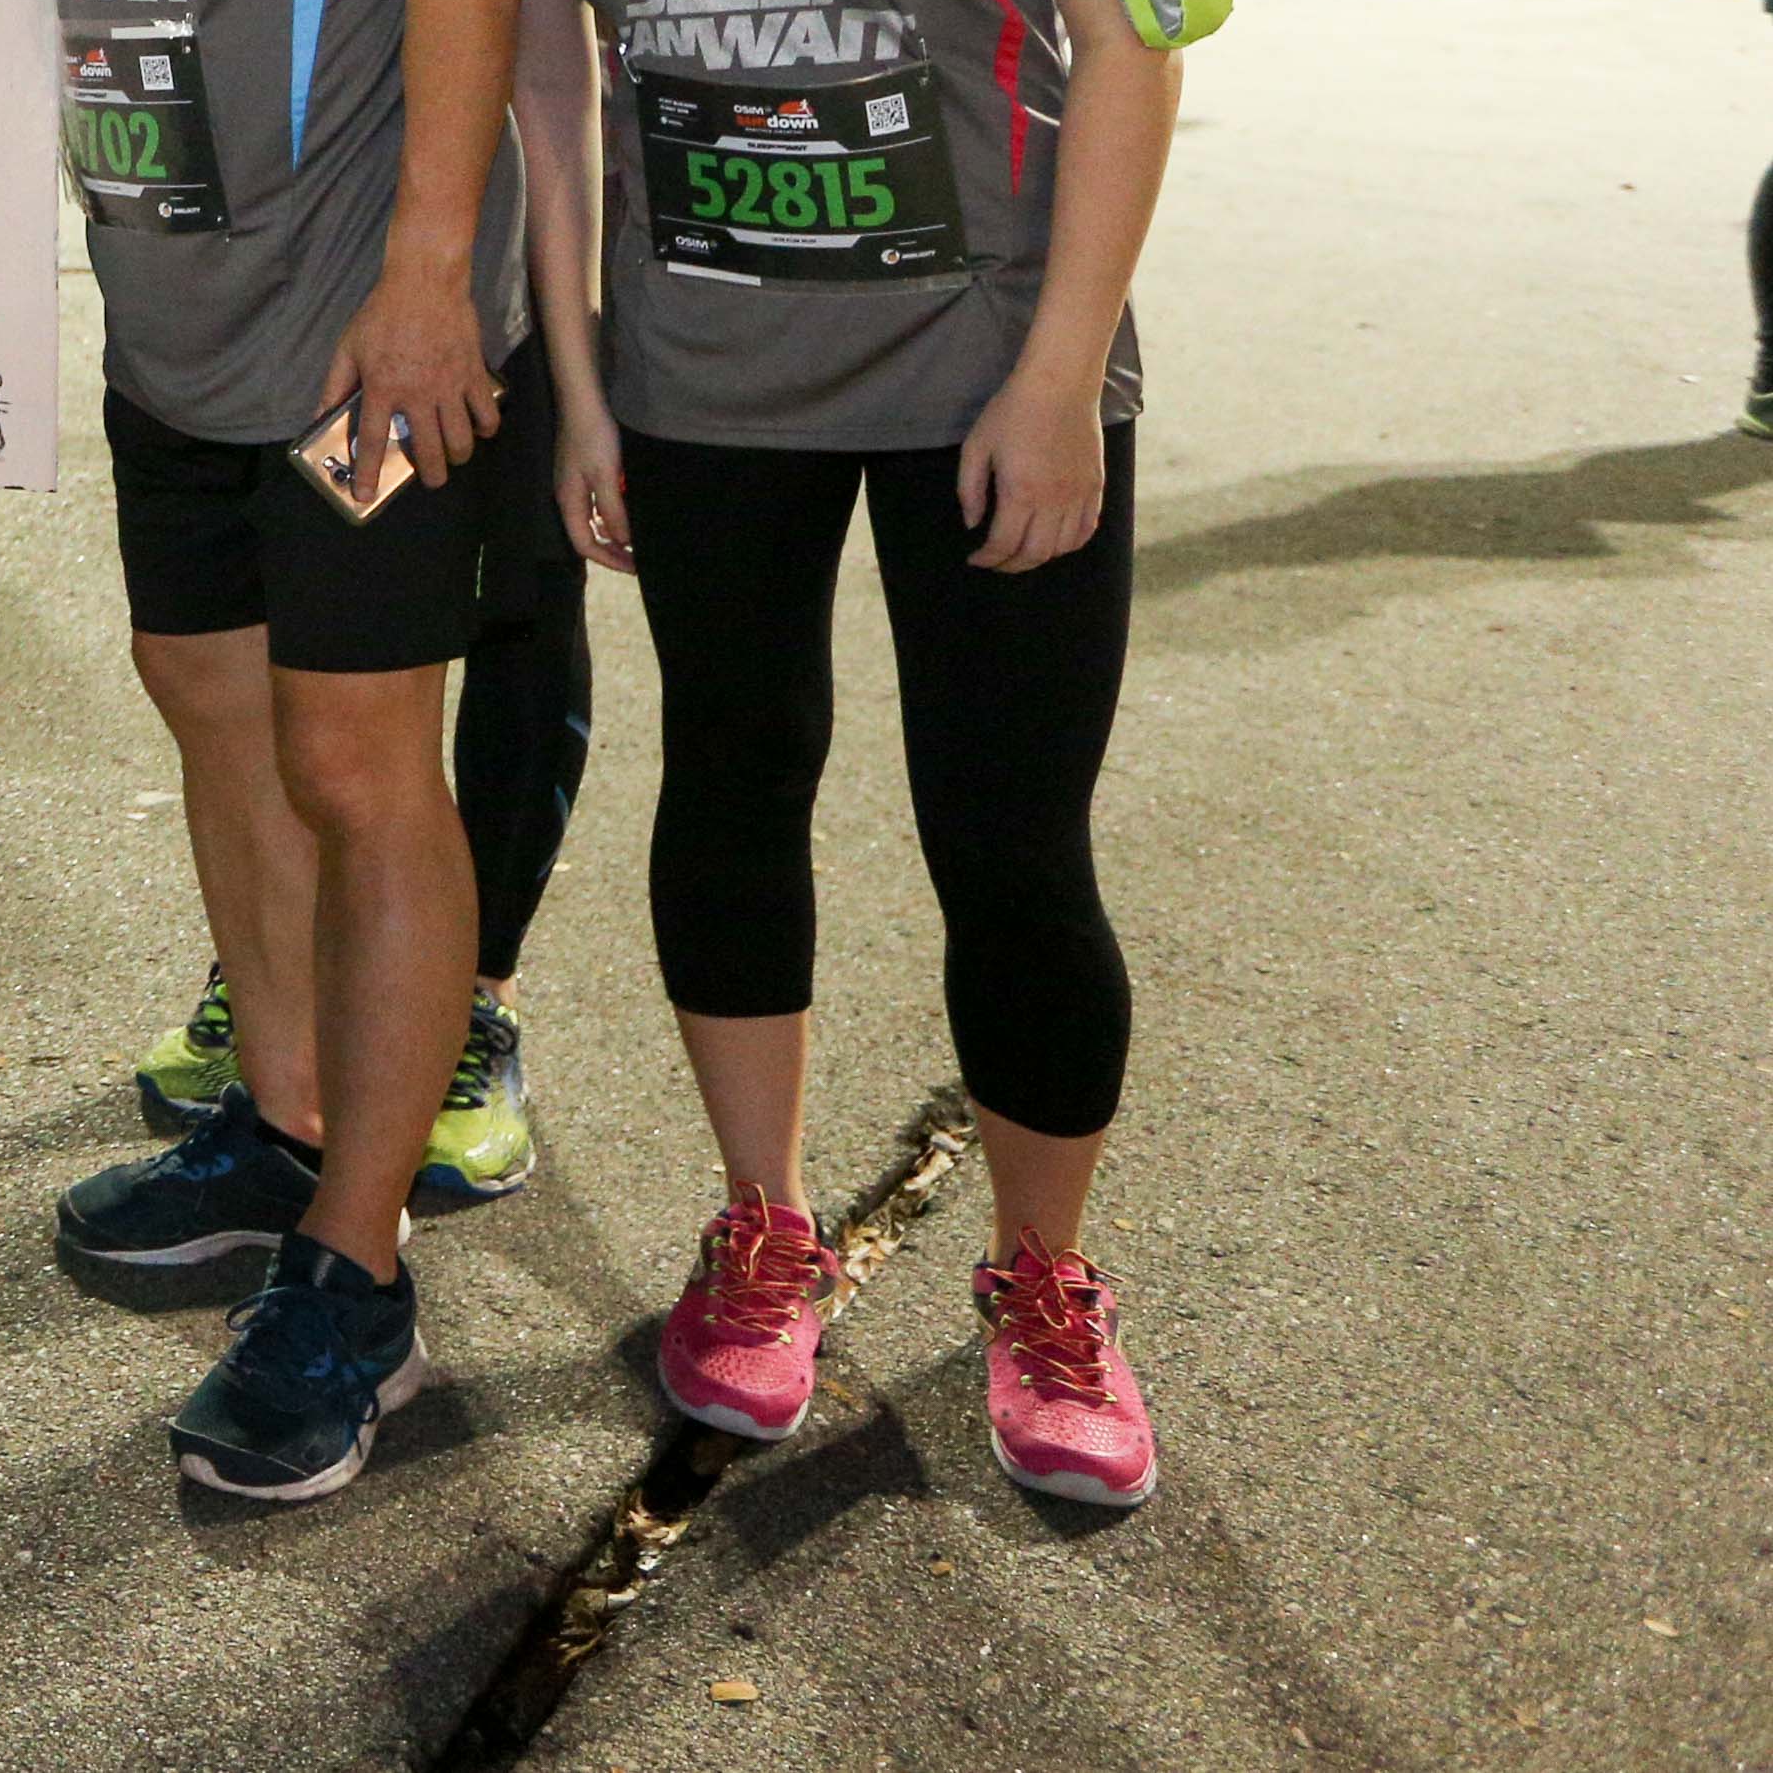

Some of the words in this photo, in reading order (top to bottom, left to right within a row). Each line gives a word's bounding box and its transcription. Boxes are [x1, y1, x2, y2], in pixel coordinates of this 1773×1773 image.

[617, 8, 916, 71] ANWAIT
[733, 103, 765, 116] OSIM
[735, 113, 820, 130] sundown
[686, 150, 896, 229] 52815
